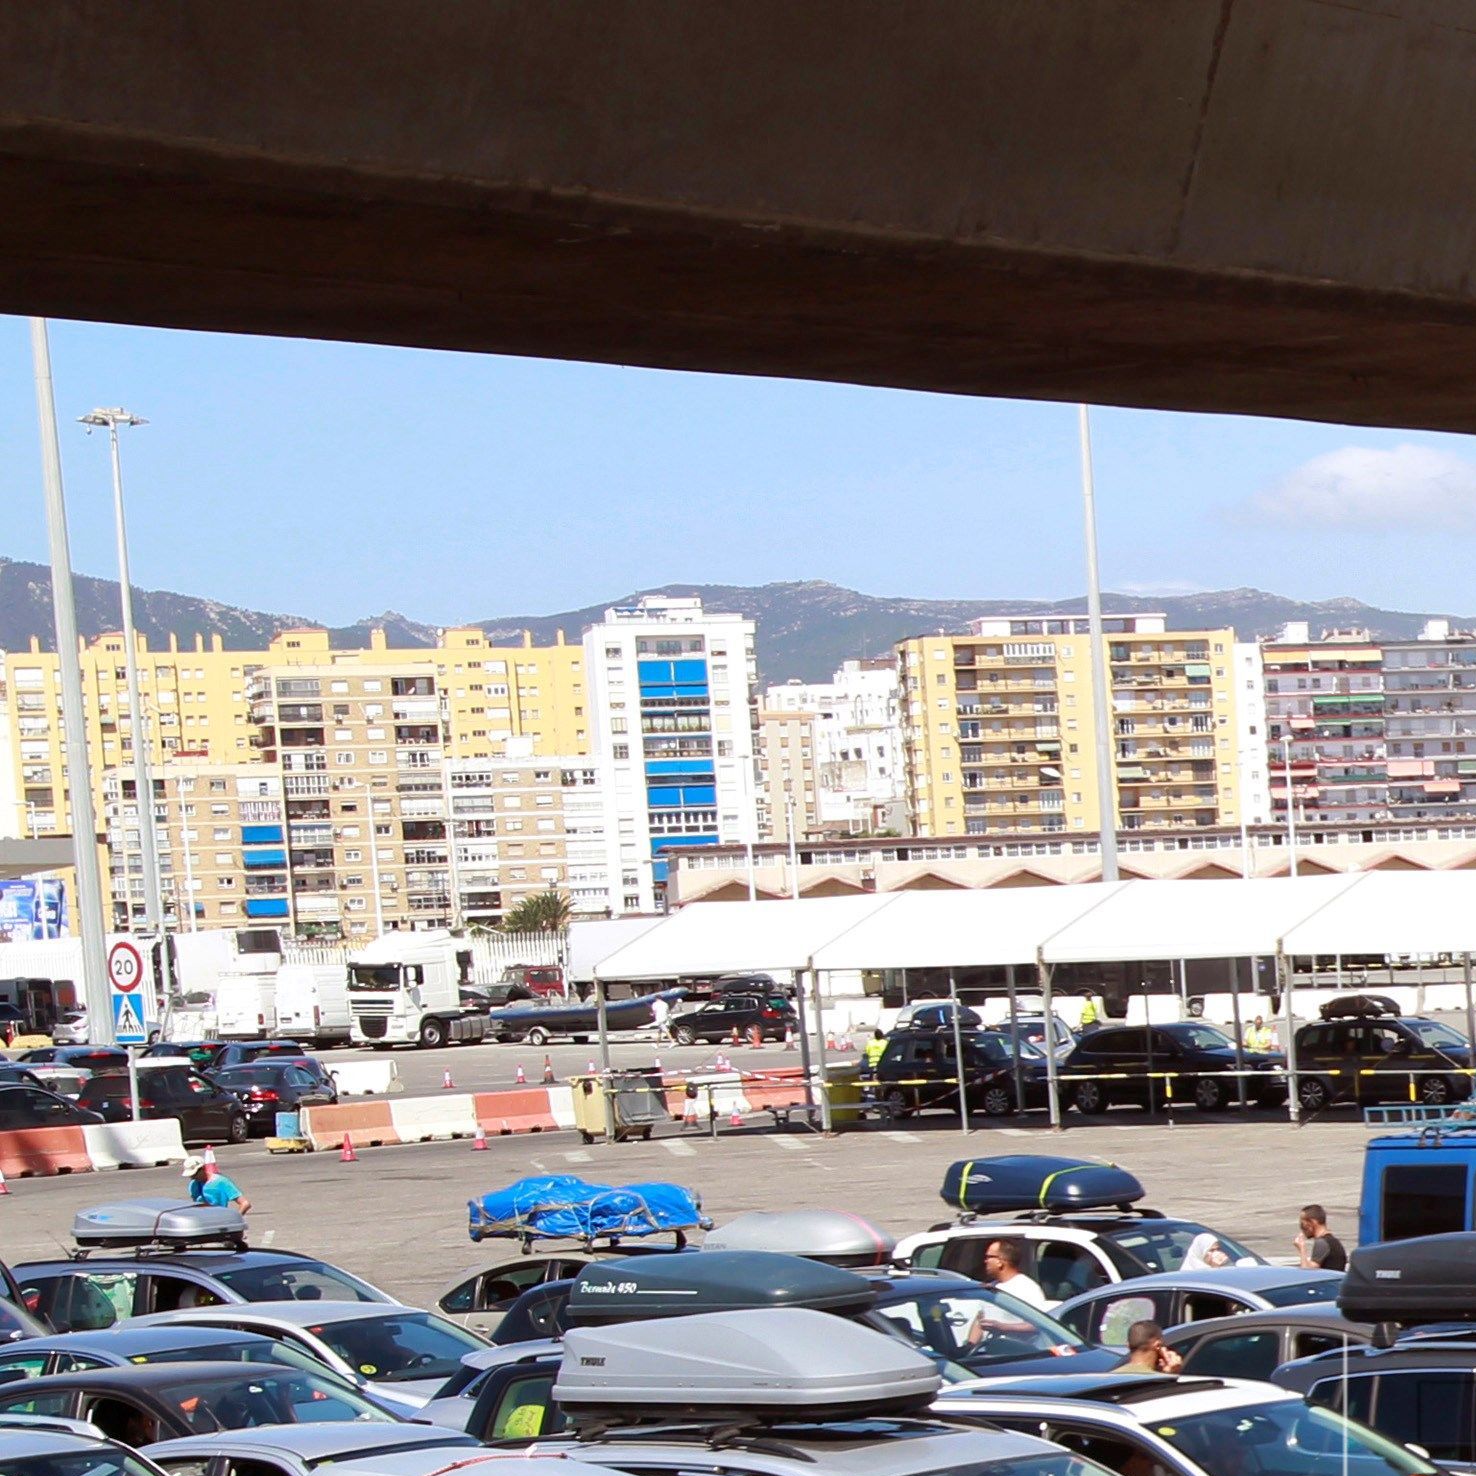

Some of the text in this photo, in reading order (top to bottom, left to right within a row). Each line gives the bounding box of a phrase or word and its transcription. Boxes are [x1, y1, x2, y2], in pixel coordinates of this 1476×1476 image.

[114, 959, 134, 975] 20
[617, 1282, 637, 1293] 450
[580, 1357, 606, 1367] THULE
